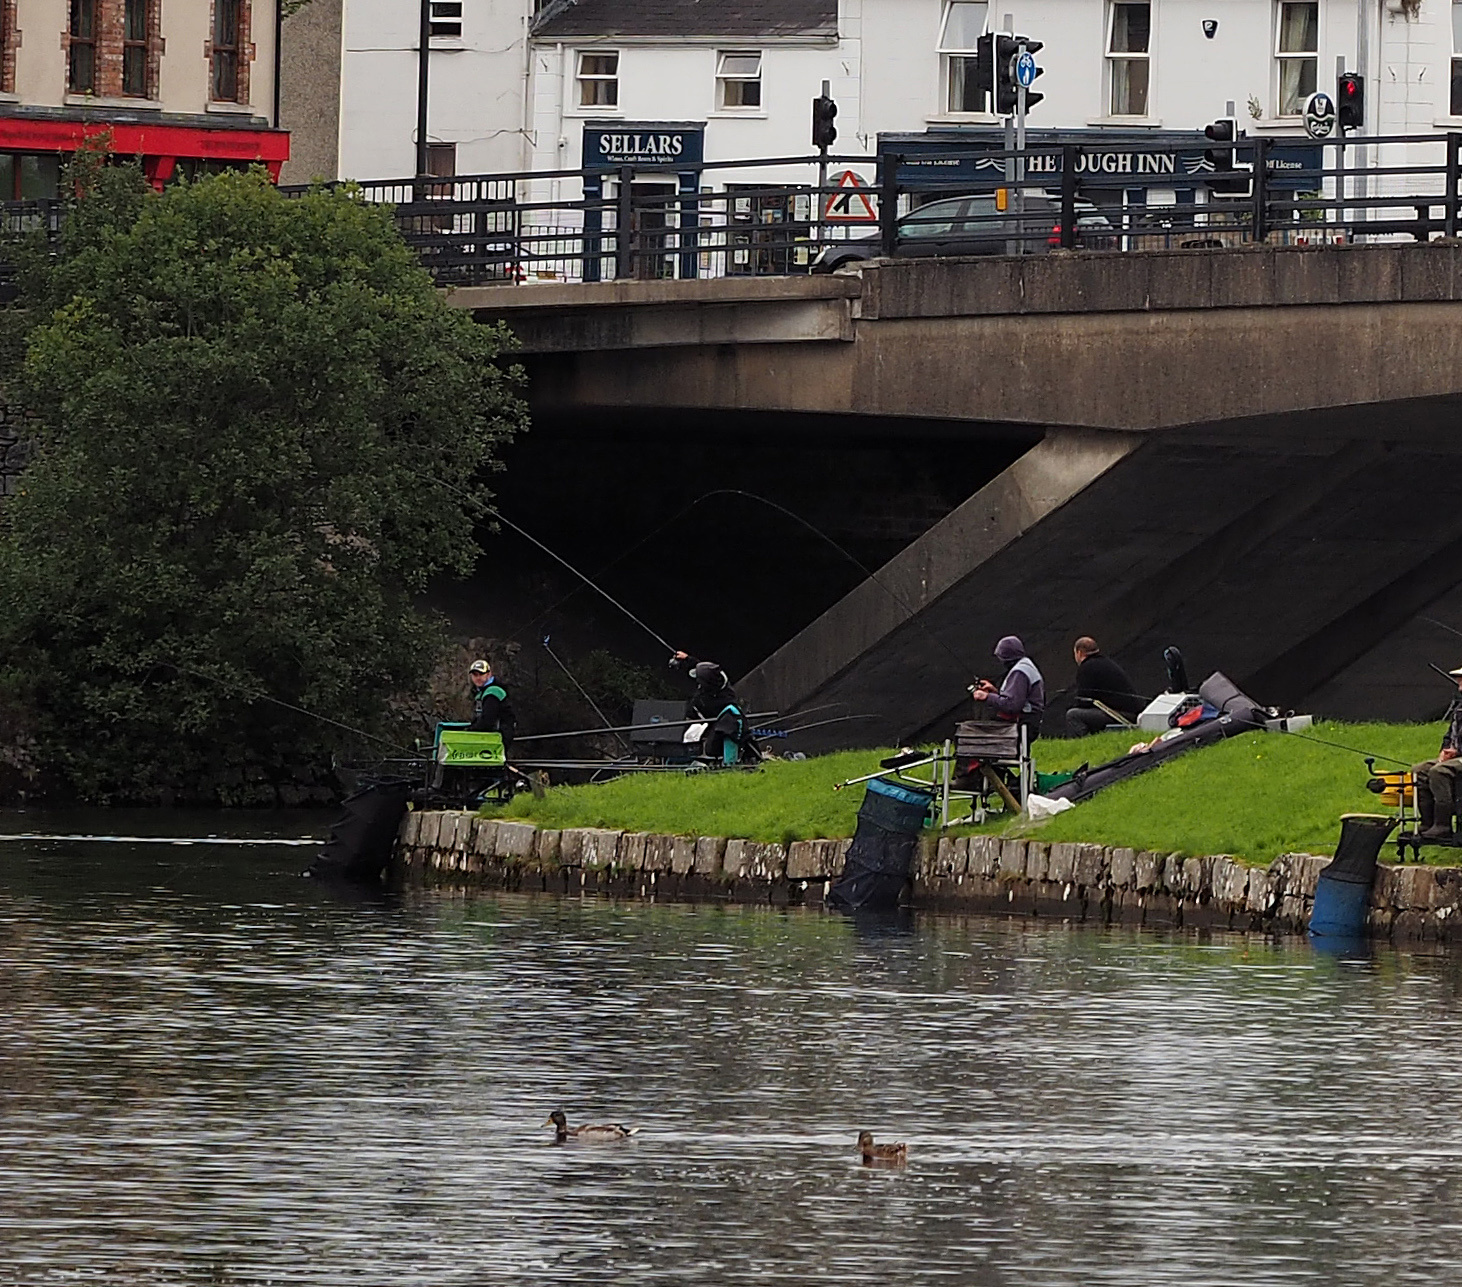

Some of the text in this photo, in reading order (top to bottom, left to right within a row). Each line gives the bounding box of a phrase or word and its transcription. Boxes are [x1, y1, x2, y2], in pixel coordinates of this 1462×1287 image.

[600, 134, 682, 155] SELLARS
[1025, 153, 1176, 173] HE OUGH INN
[1276, 159, 1303, 169] License
